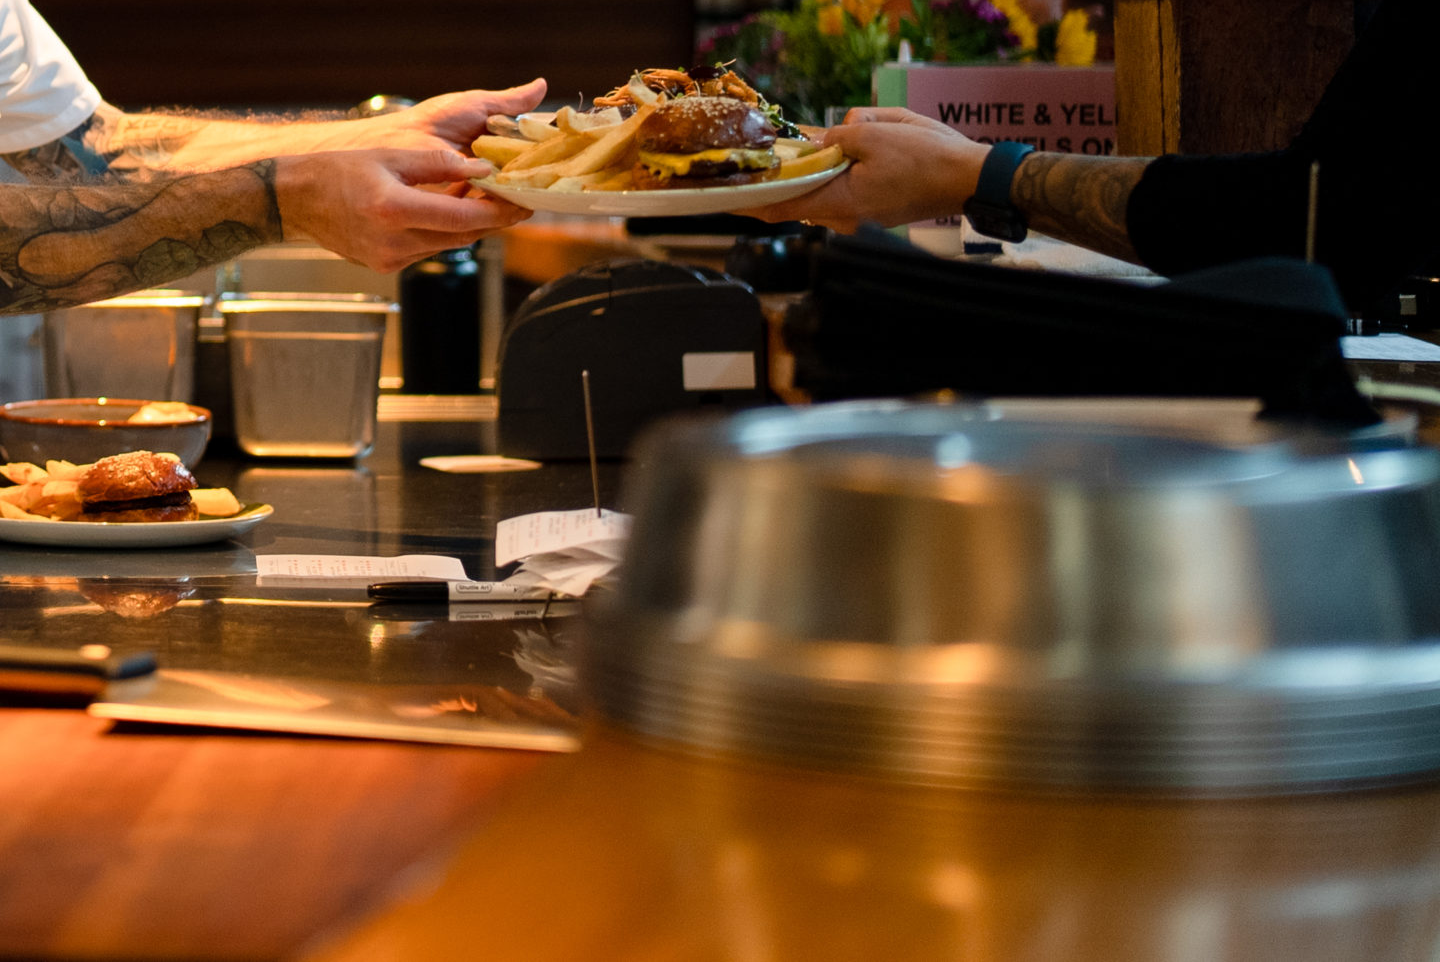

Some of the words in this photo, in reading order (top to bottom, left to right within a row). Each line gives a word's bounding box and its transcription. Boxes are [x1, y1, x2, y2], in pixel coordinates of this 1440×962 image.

[938, 102, 1024, 125] WHITE
[1033, 103, 1052, 125] &
[1061, 103, 1119, 126] YEL
